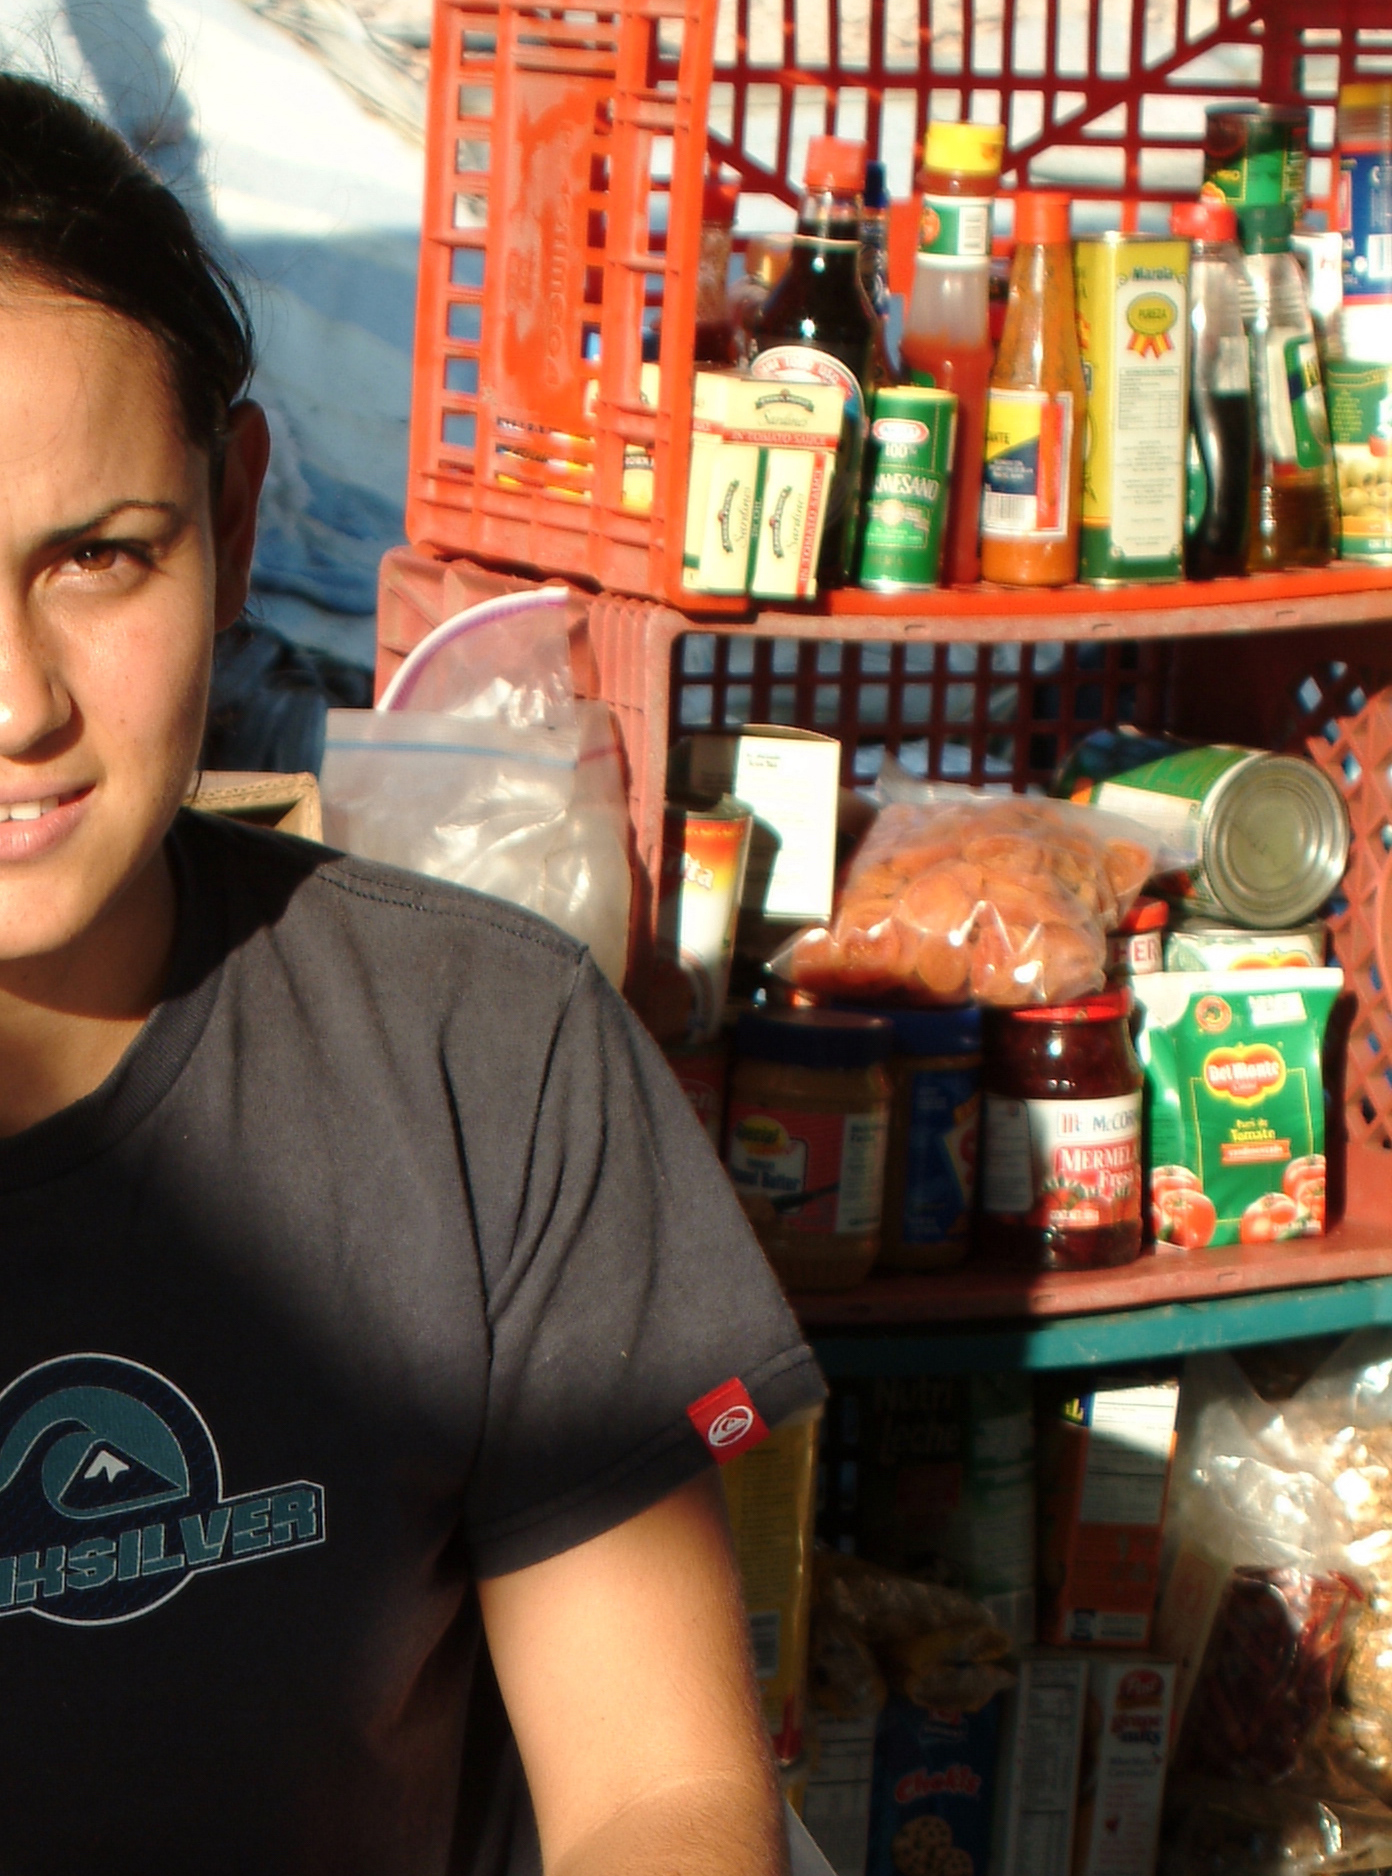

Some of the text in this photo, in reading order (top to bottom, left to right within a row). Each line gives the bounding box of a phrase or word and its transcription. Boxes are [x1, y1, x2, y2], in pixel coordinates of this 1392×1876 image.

[747, 431, 792, 443] TOMATO
[794, 434, 826, 446] SAUCE
[802, 515, 819, 568] TOMATO
[811, 468, 825, 513] SAUCE
[1208, 1060, 1281, 1083] Del Monte
[1230, 1128, 1276, 1142] Tomate
[894, 1763, 984, 1806] Chokis
